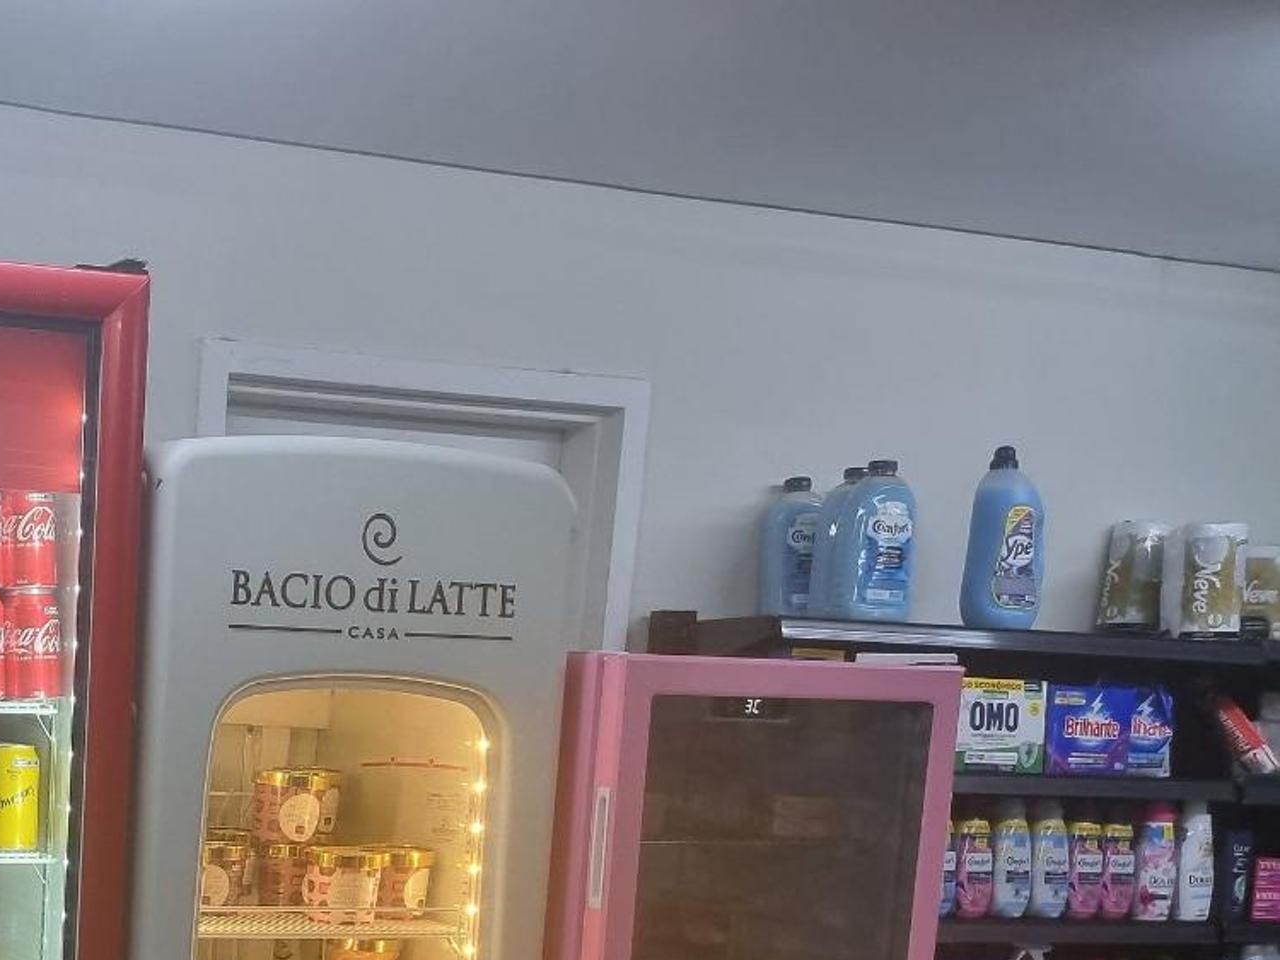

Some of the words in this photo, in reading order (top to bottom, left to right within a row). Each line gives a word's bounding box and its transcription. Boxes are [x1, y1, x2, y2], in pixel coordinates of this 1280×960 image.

[230, 569, 356, 611] BACIO
[363, 578, 399, 613] di
[407, 579, 517, 619] LATTE
[348, 625, 400, 640] CASA
[969, 701, 1020, 732] OMO
[1065, 717, 1120, 739] Brilhante
